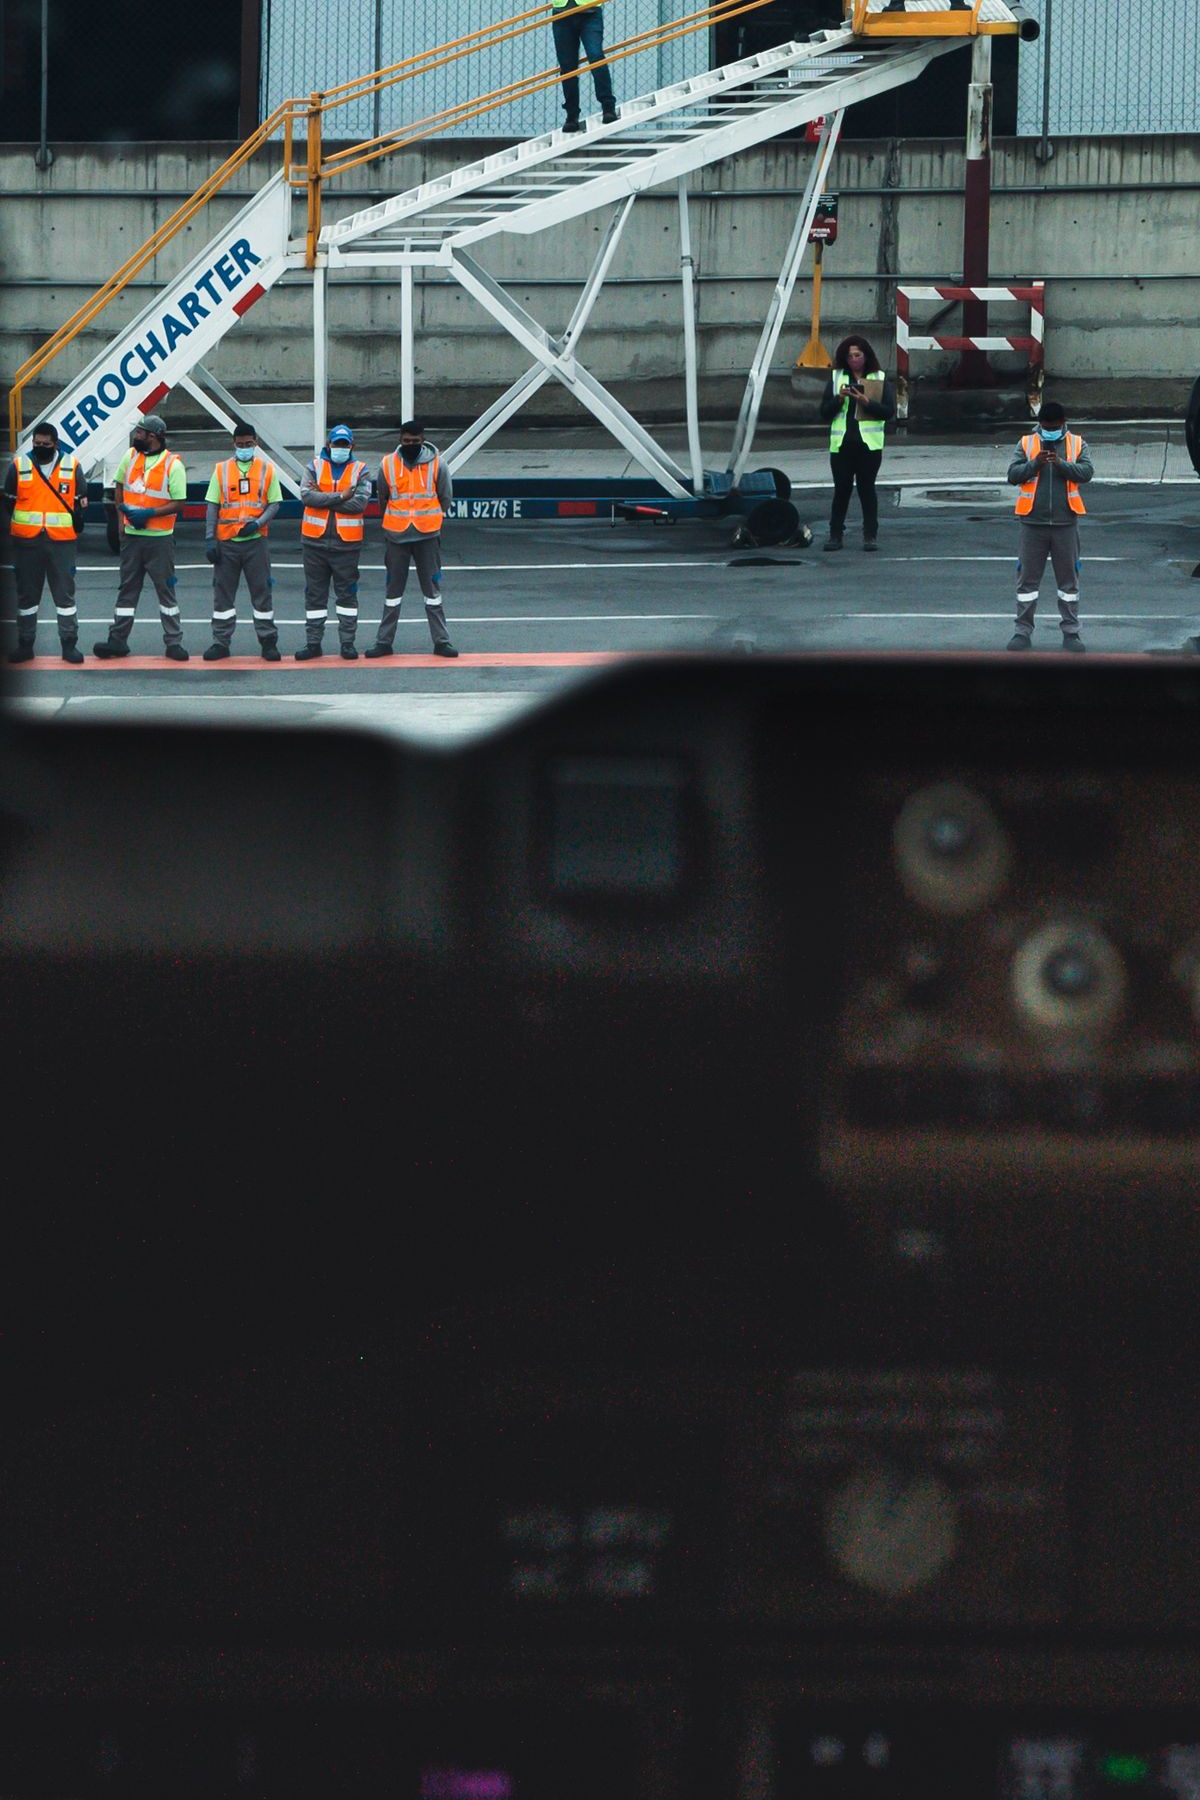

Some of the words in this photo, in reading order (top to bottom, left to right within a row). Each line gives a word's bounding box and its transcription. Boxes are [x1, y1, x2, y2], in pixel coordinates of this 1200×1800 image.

[443, 500, 468, 518] CM
[472, 500, 508, 519] 9276
[513, 500, 522, 518] E
